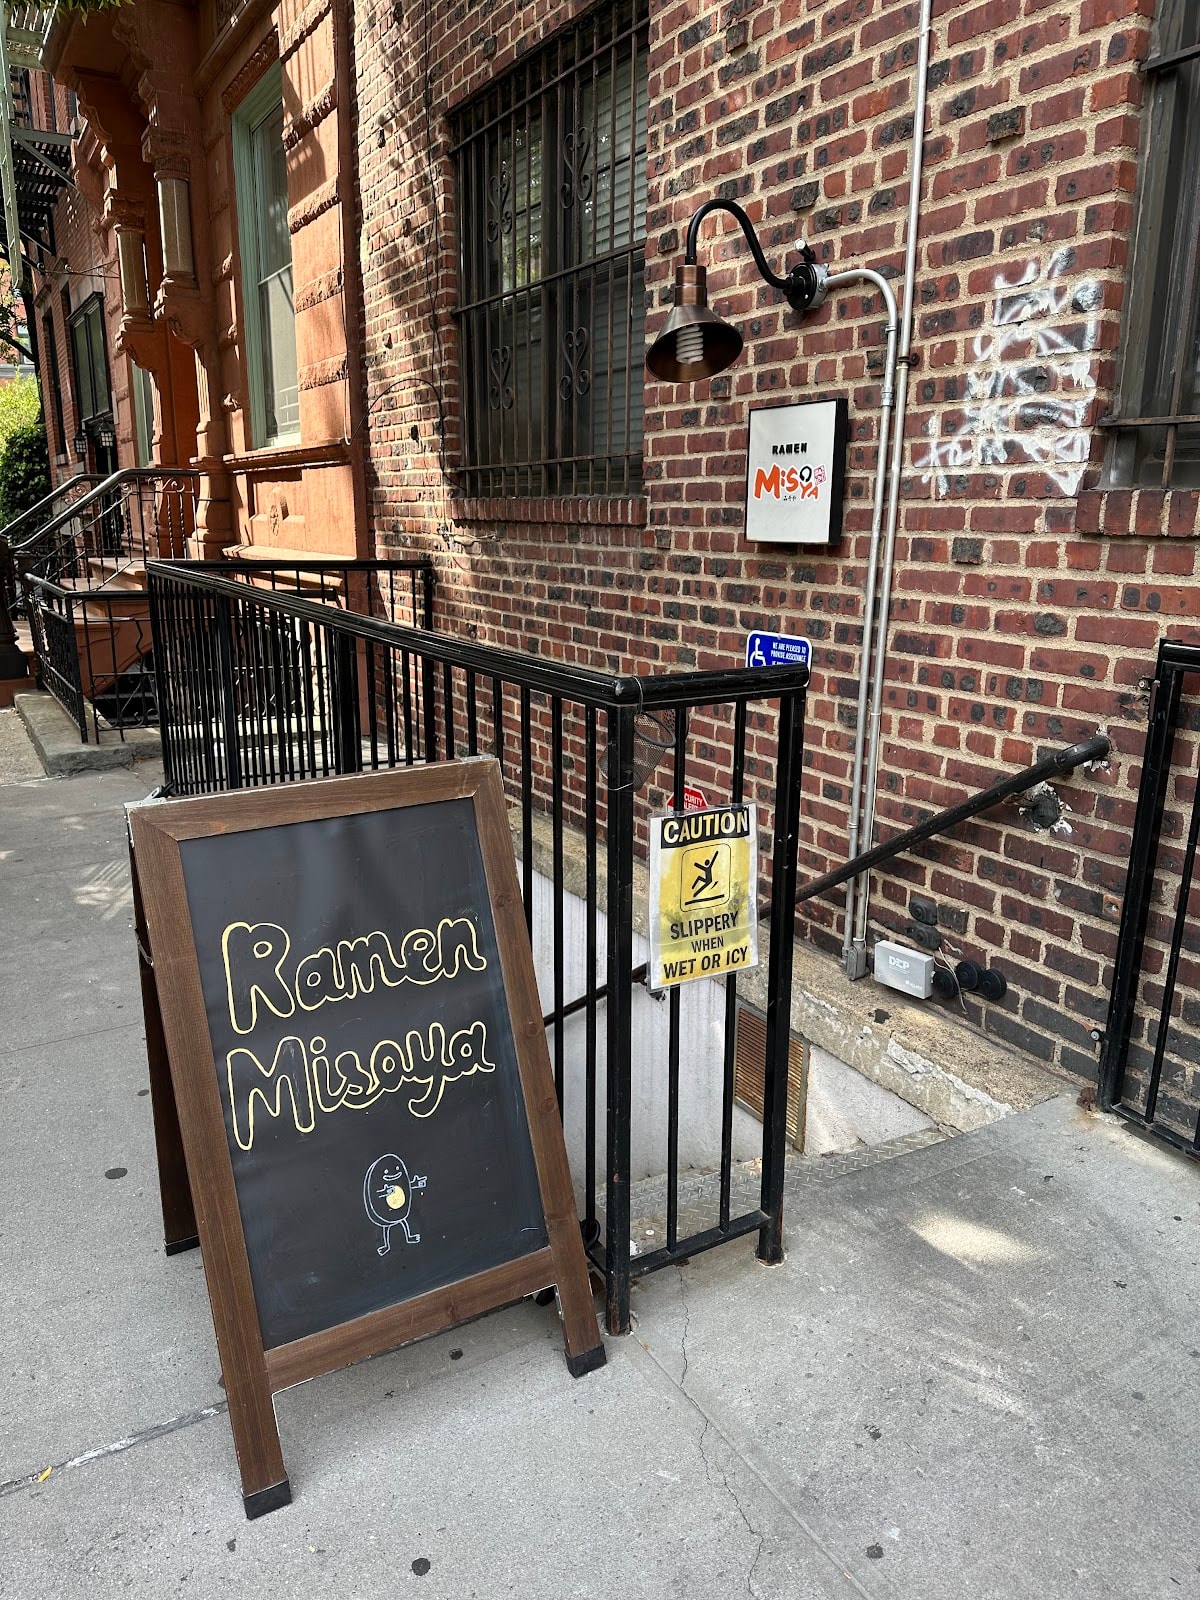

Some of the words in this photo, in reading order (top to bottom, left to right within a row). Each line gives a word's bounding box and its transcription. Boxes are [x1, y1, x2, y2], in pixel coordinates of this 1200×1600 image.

[772, 443, 808, 455] RAMEN
[771, 650, 786, 659] PROVIDE
[772, 642, 778, 650] WE
[786, 644, 801, 653] PLEASED
[801, 646, 807, 655] TO
[684, 793, 703, 806] CURITY
[663, 810, 748, 844] CAUTION
[670, 910, 739, 940] SLIPPERY
[691, 935, 724, 953] WHEN
[663, 957, 697, 980] WET
[701, 953, 721, 971] OR
[726, 946, 748, 966] ICY
[221, 917, 488, 1035] Ramen
[226, 1020, 496, 1151] Misoya
